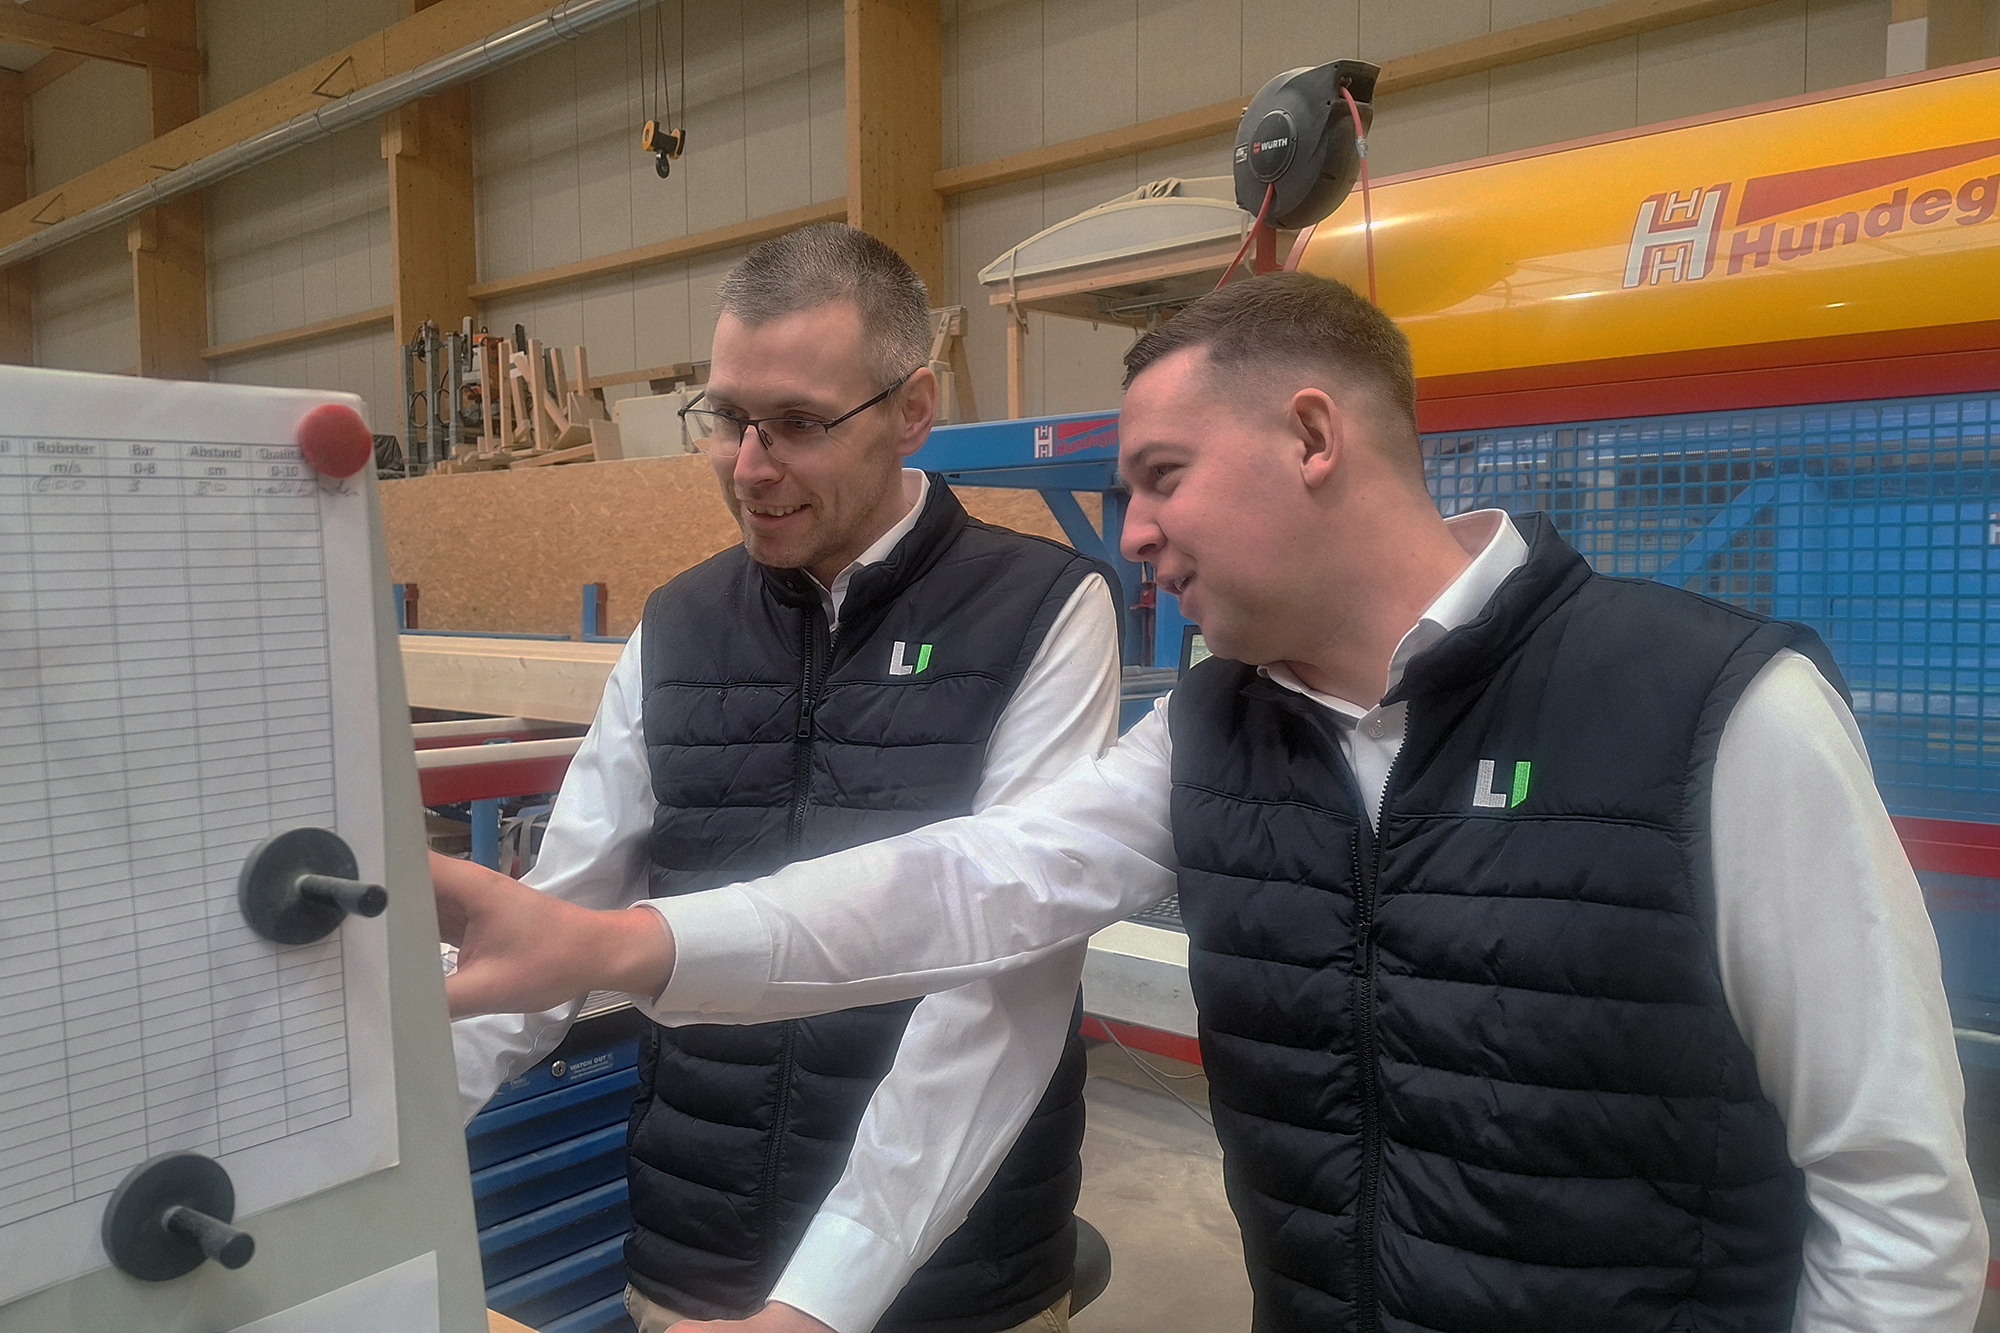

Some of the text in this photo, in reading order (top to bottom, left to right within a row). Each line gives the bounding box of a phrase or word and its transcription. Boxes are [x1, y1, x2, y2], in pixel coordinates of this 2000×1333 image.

[1727, 174, 2000, 275] Hundeg
[1057, 429, 1118, 456] Hundegg
[131, 443, 155, 457] Bar
[188, 446, 242, 459] Abstand
[54, 460, 82, 474] m/s
[570, 1059, 593, 1071] WATCH
[593, 1055, 607, 1064] OUT
